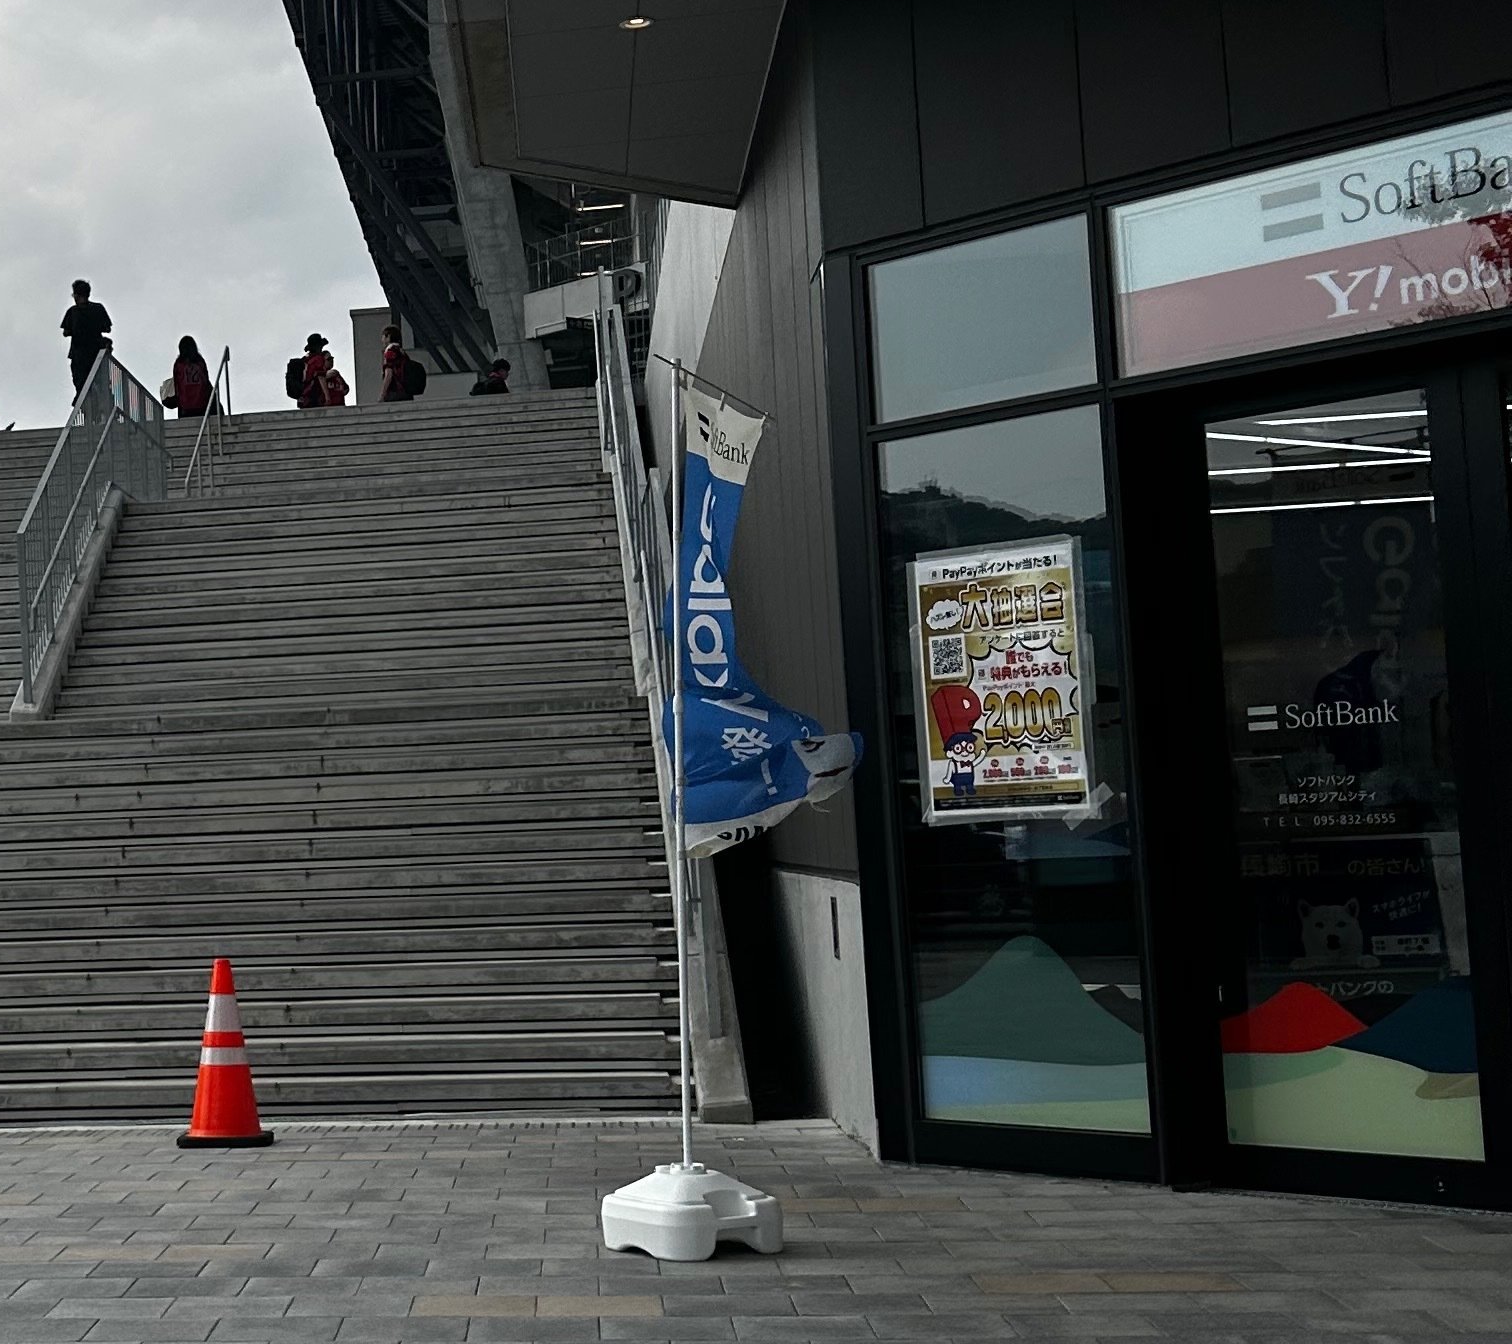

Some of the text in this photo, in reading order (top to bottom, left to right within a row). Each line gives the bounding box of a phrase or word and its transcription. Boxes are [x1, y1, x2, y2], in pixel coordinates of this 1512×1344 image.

[960, 583, 1065, 630] 大抽選会
[979, 628, 1065, 645] アンケートに回答すると
[1005, 650, 1034, 665] 誰でも
[1285, 699, 1399, 729] SoftBank
[1297, 775, 1355, 788] ソフトバンク
[1279, 790, 1375, 805] 長崎スタジアムシティ
